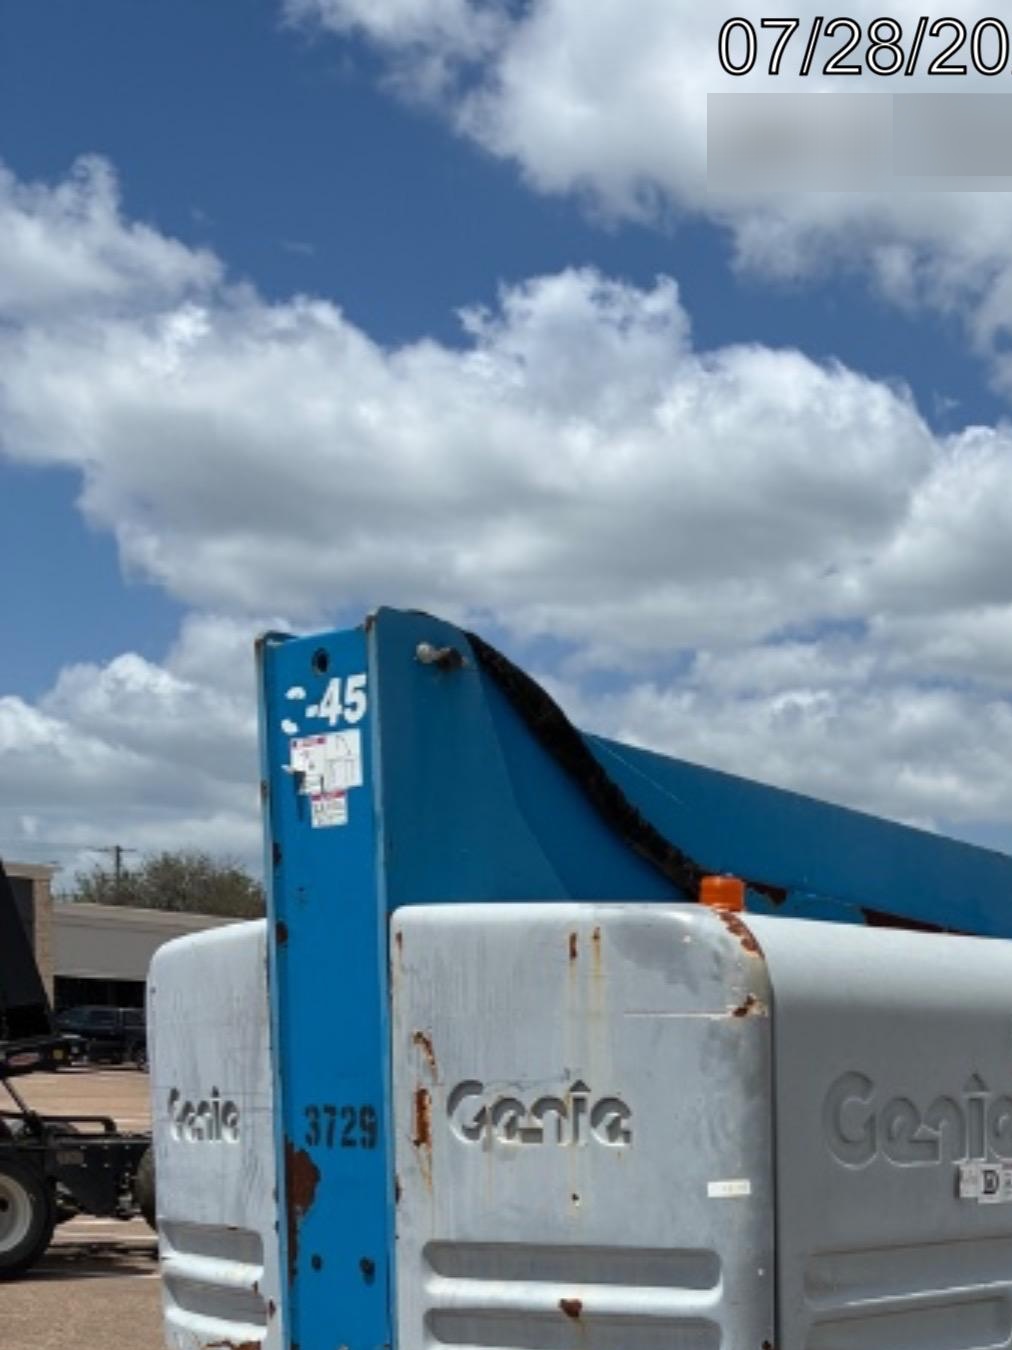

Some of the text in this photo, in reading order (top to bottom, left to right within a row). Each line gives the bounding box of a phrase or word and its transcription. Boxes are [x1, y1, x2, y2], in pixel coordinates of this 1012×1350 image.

[167, 1086, 241, 1144] Genie
[304, 1103, 377, 1150] 3729
[446, 1078, 632, 1147] Genie
